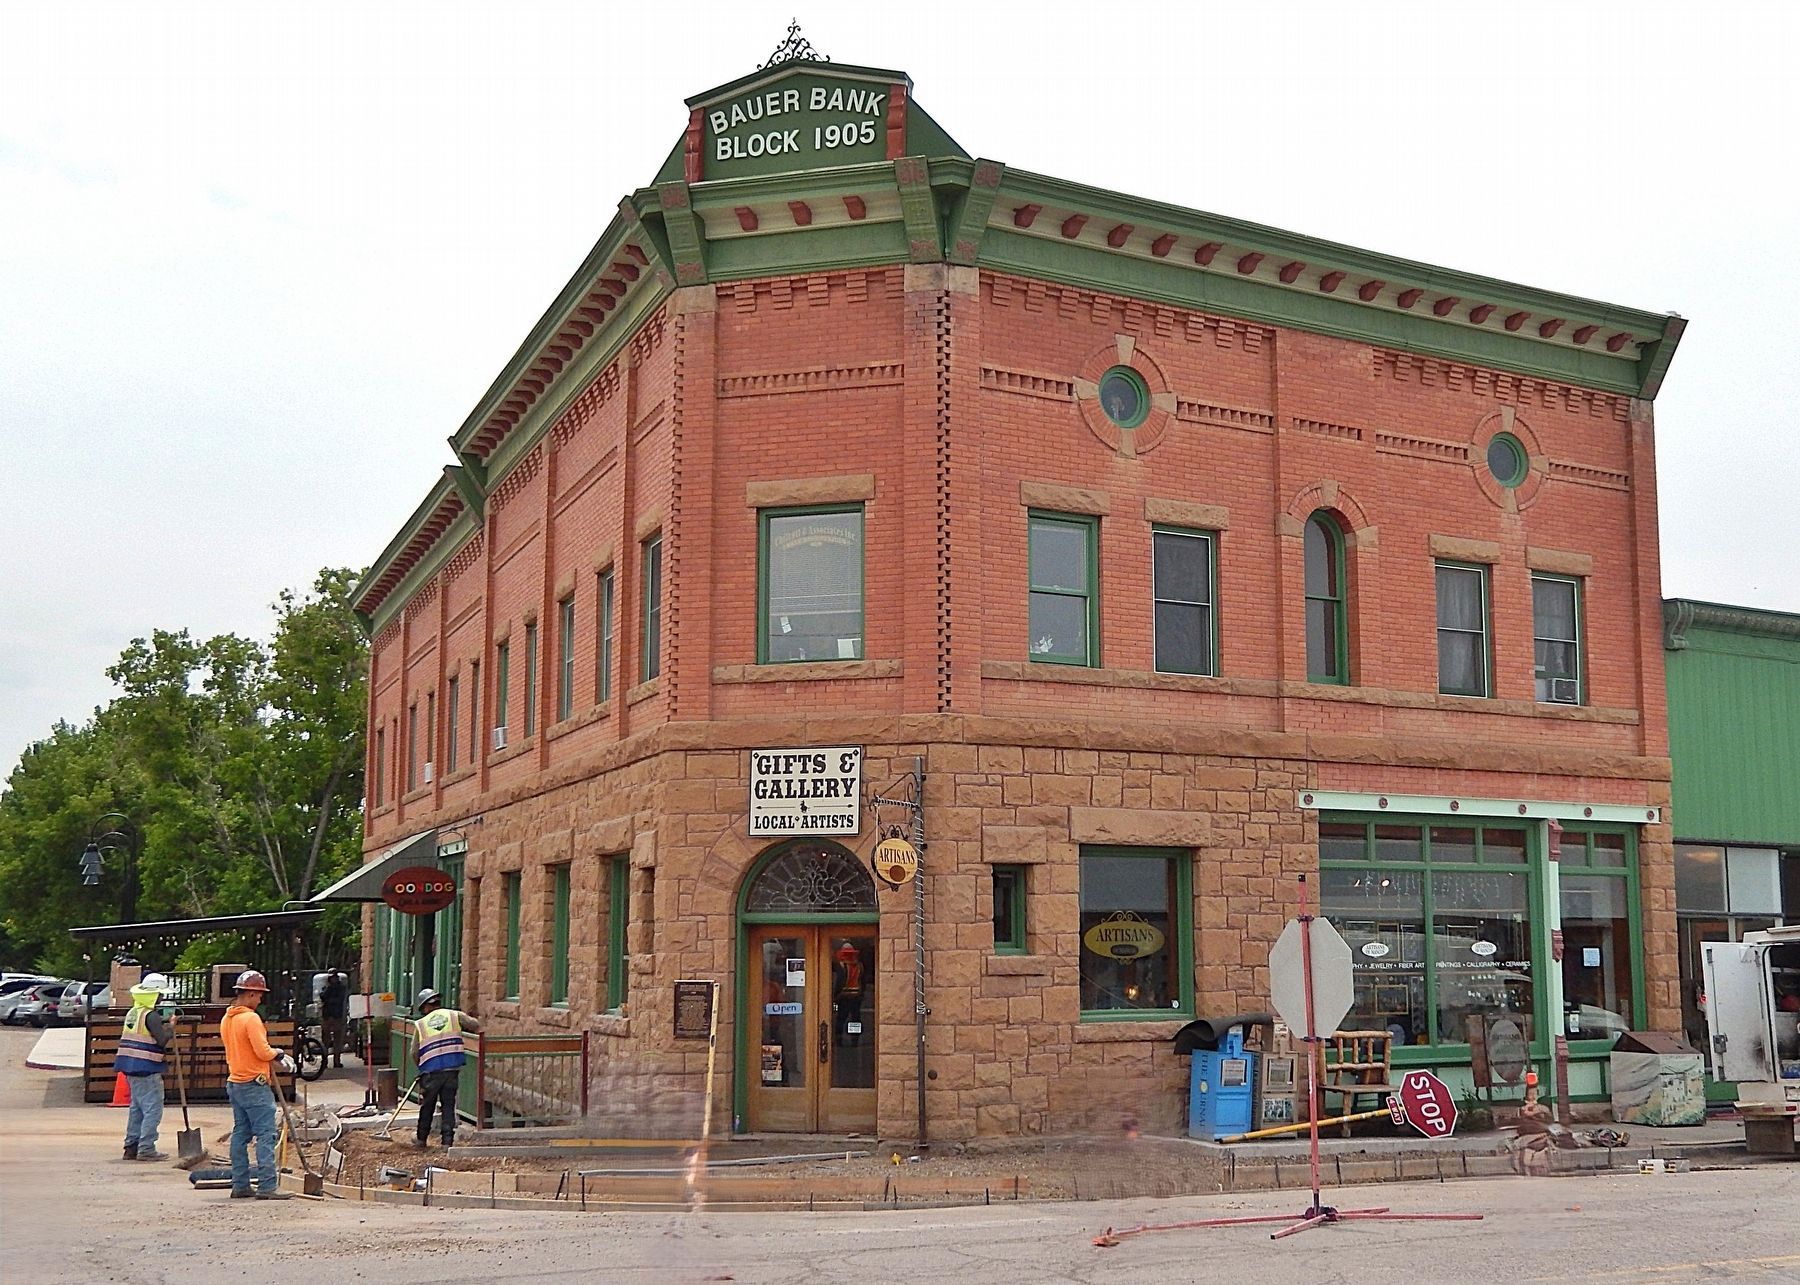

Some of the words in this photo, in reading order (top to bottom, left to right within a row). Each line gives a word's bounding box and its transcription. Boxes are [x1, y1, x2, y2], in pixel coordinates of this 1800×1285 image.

[710, 89, 799, 135] BAUER
[809, 87, 886, 117] BANK
[716, 129, 800, 161] BLOCK
[815, 120, 876, 149] 1905
[756, 754, 827, 775] GIFTS
[839, 753, 855, 774] &
[754, 777, 857, 799] GALLERY
[754, 815, 795, 829] LOCAL
[800, 814, 854, 828] ARTISTS
[879, 847, 915, 865] ARTISANS
[1096, 928, 1154, 942] ARTISANS
[1505, 960, 1531, 968] CERAMICS
[772, 1004, 797, 1014] Open
[1410, 1076, 1446, 1132] STOP
